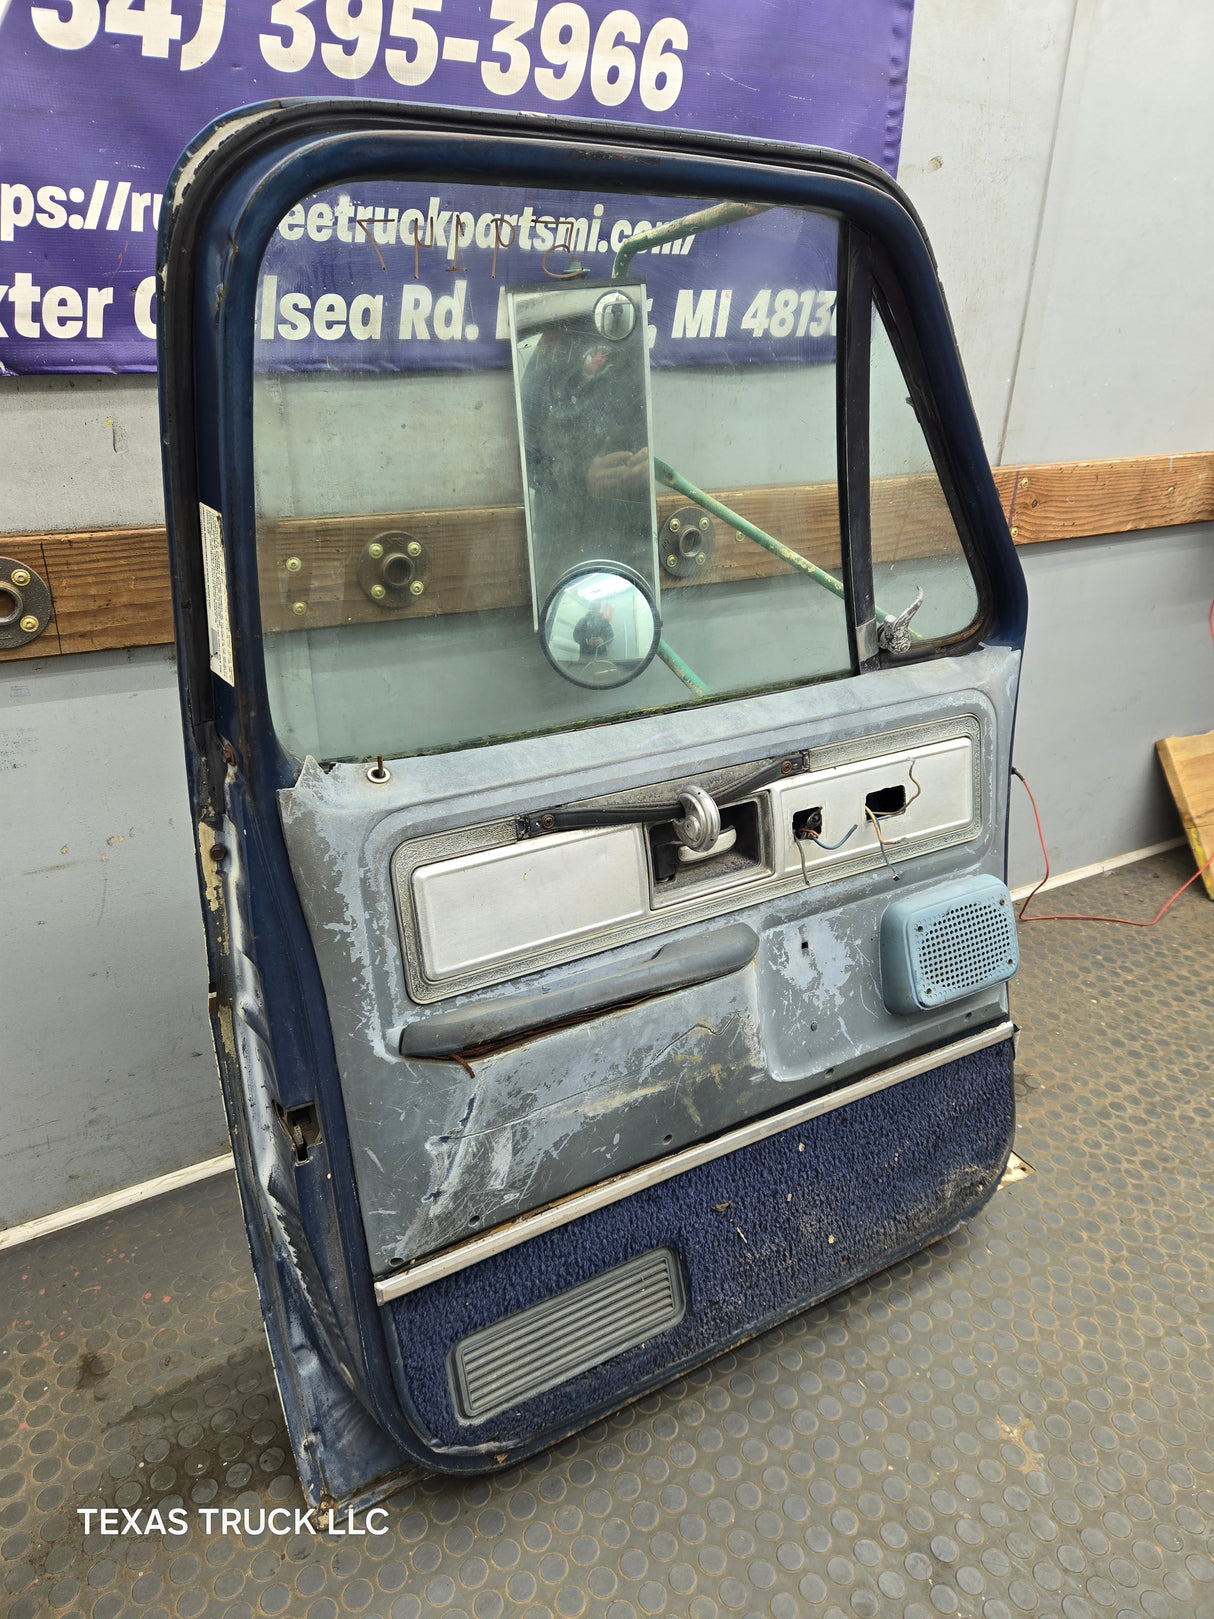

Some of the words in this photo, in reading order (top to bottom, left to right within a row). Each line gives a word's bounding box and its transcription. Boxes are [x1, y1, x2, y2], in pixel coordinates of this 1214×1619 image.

[259, 0, 689, 112] 395-3966
[0, 272, 114, 339] ter
[399, 279, 479, 341] Rd.
[671, 289, 733, 338] MI
[741, 288, 837, 338] 4813
